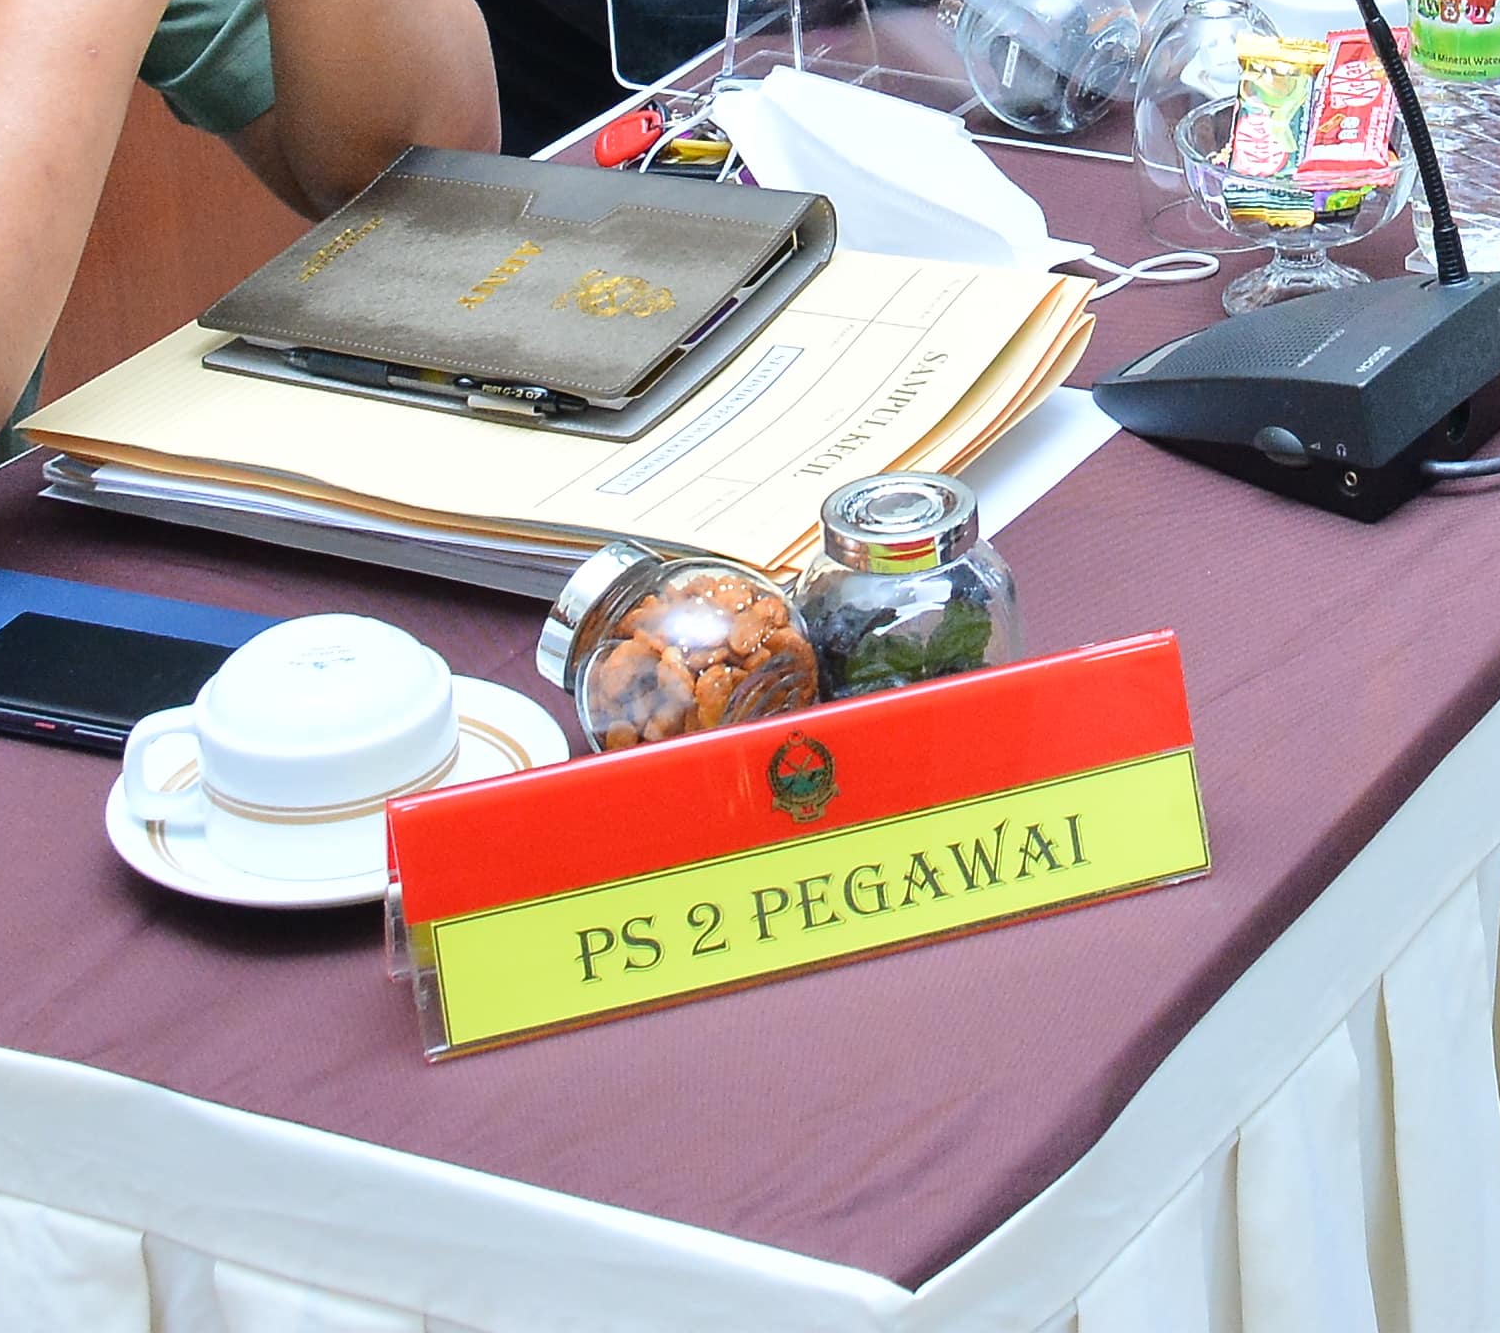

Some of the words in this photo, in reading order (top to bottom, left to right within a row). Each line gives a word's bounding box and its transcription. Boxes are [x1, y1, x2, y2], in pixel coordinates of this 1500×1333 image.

[1437, 51, 1471, 66] Mineral
[857, 350, 949, 430] SAMPUL
[792, 432, 872, 477] KECIL
[575, 913, 663, 985] PS
[686, 901, 731, 957] 2
[750, 812, 1093, 945] PEGAWAI
